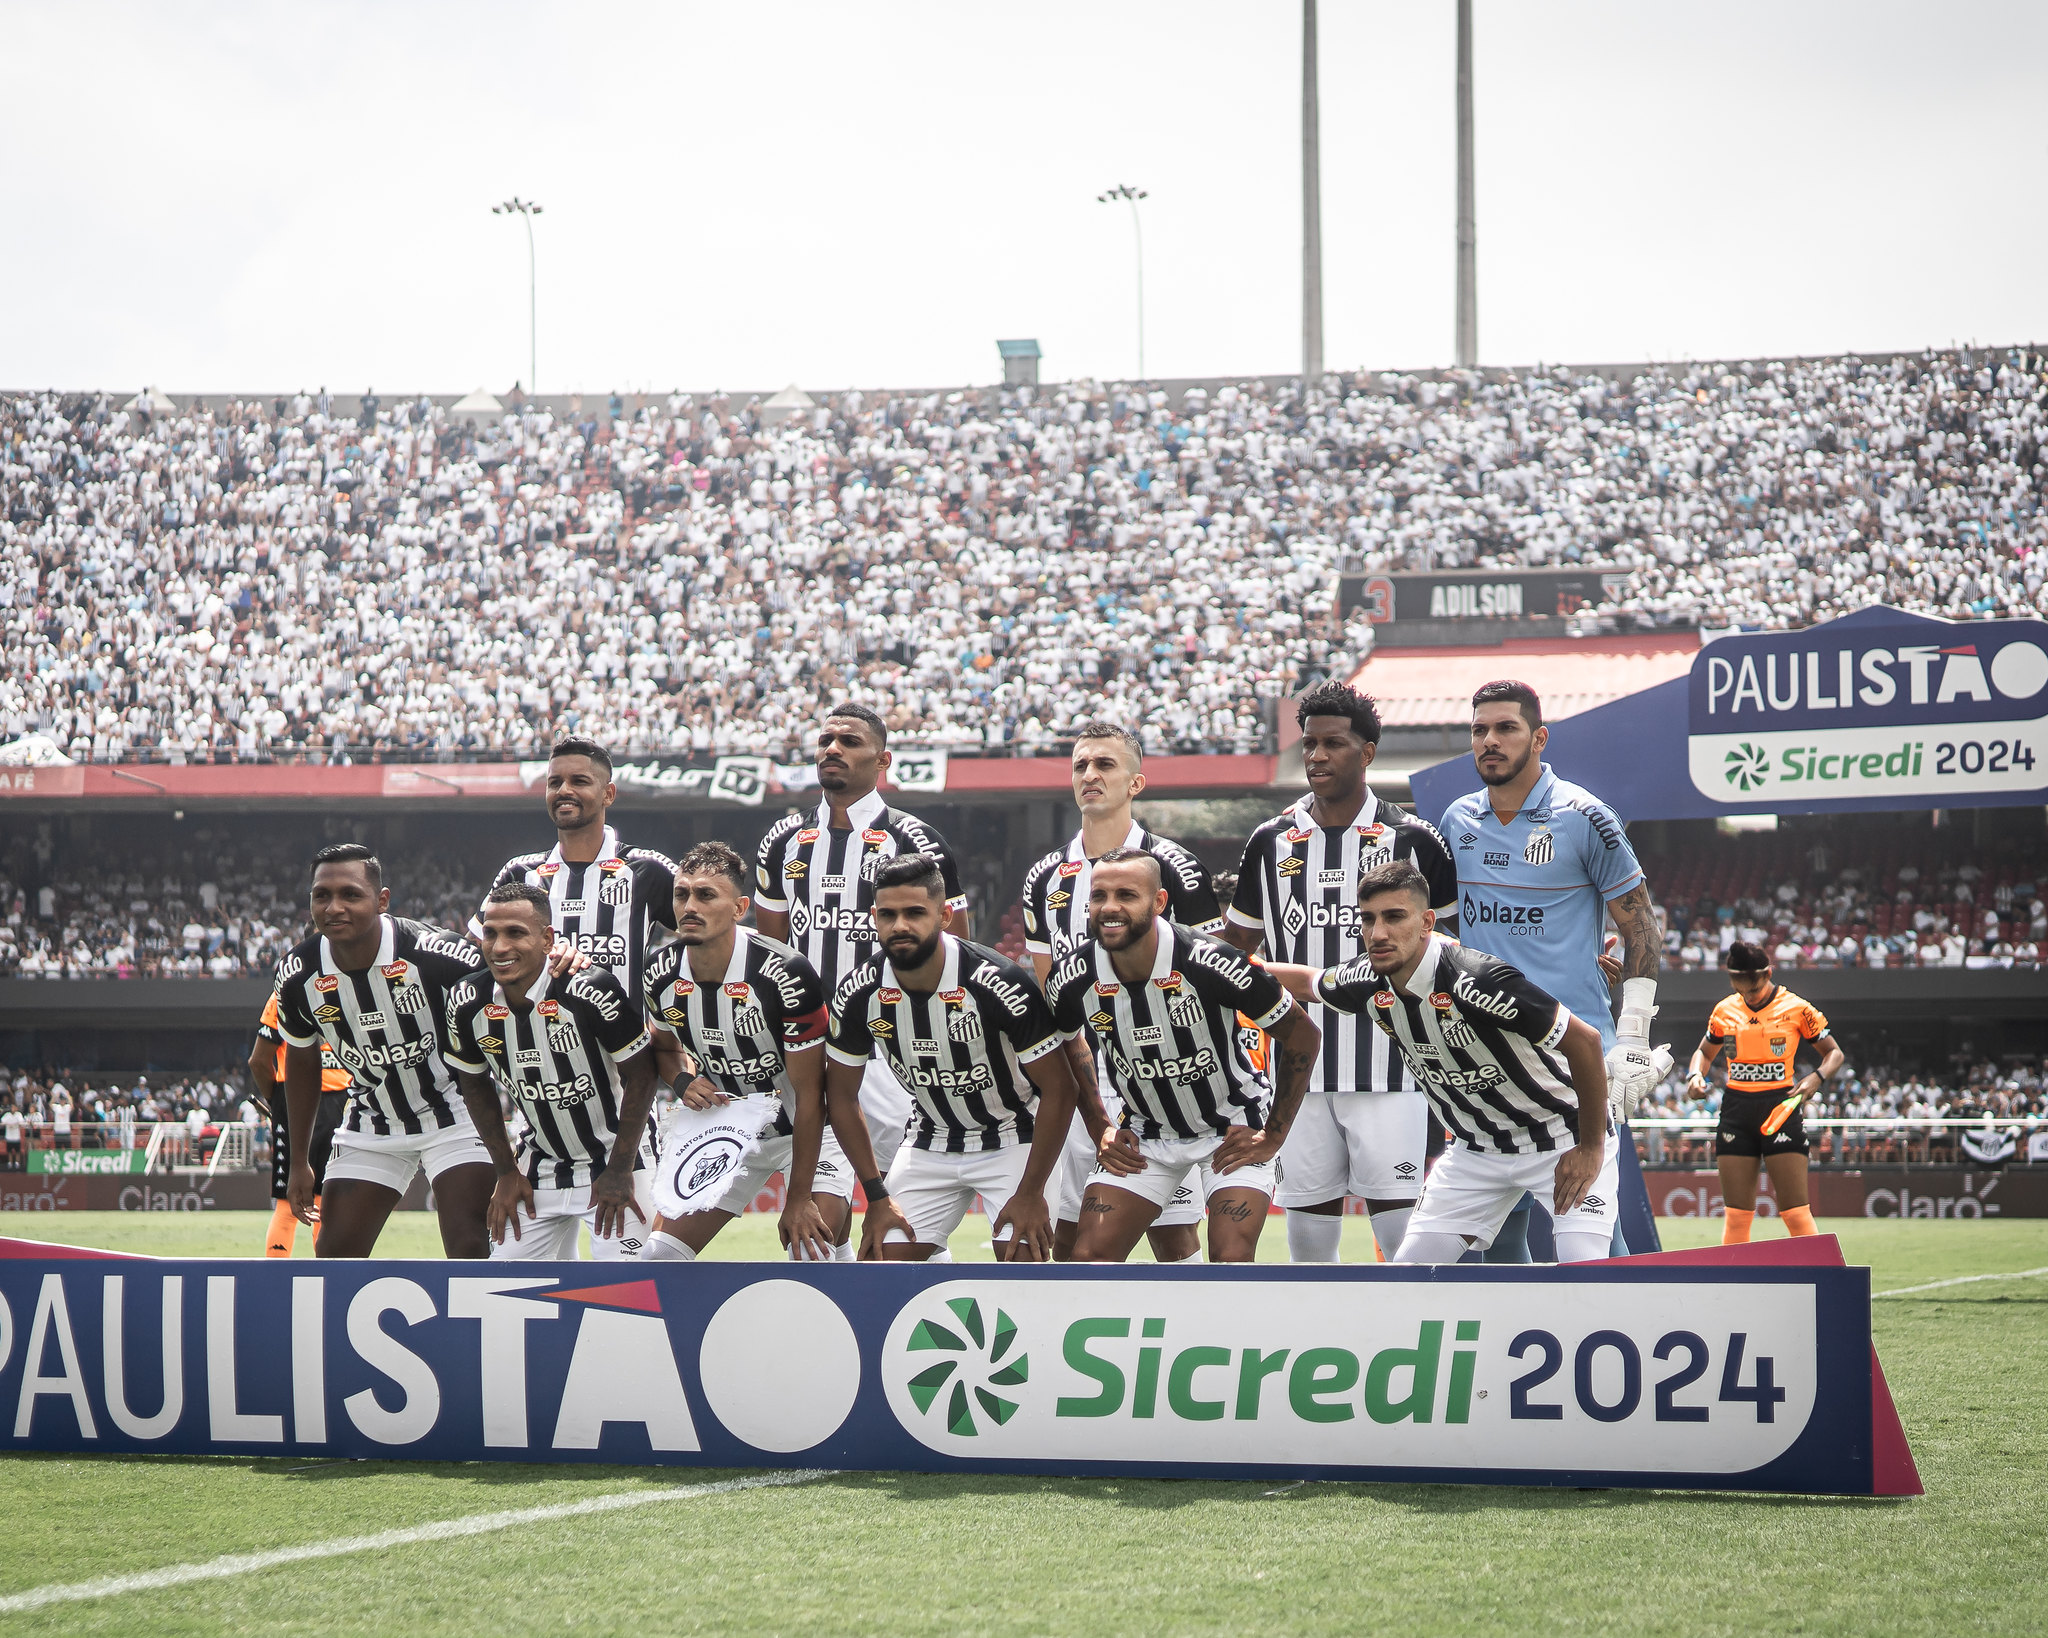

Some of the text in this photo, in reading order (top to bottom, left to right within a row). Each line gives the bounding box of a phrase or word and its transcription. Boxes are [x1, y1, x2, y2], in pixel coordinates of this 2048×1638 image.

[1361, 575, 1397, 623] 3
[1430, 582, 1523, 618] ADILSON
[1780, 739, 2036, 782] Sicredi 2024
[1483, 859, 1510, 867] BOND
[1485, 852, 1510, 860] TEK
[1279, 869, 1302, 877] umbro
[1048, 902, 1067, 910] umbro
[1479, 901, 1545, 924] blaze
[1507, 925, 1545, 937] .com
[413, 930, 481, 968] Kicaldo
[590, 953, 627, 965] com
[1188, 940, 1253, 991] Kicaldo
[758, 950, 806, 1009] Kicaldo
[969, 959, 1030, 1017] Kicaldo
[564, 976, 621, 1021] Kicaldo
[1452, 970, 1520, 1020] Kicaldo
[360, 1018, 385, 1026] BOND
[1094, 1024, 1114, 1032] umbro
[1133, 1028, 1160, 1036] TEK
[873, 1031, 893, 1039] umbro
[1133, 1033, 1161, 1042] BOND
[366, 1034, 433, 1066] blaze
[404, 1044, 435, 1071] .com
[704, 1052, 777, 1076] blaze
[744, 1065, 782, 1084] .com
[911, 1063, 988, 1087] blaze
[1134, 1049, 1212, 1079] blaze
[1178, 1063, 1218, 1087] .com
[1423, 1064, 1499, 1087] blaze
[520, 1073, 592, 1101] blaze
[952, 1079, 992, 1097] .com
[1465, 1076, 1505, 1095] .com
[558, 1087, 595, 1110] .com
[675, 1132, 704, 1158] SANTOS
[703, 1125, 737, 1137] FUTEBOL
[61, 1150, 133, 1174] Sicredi
[1580, 1206, 1605, 1216] umbro
[0, 1273, 861, 1453] AULISTÃO
[1055, 1316, 1786, 1425] Sicredi 2024
